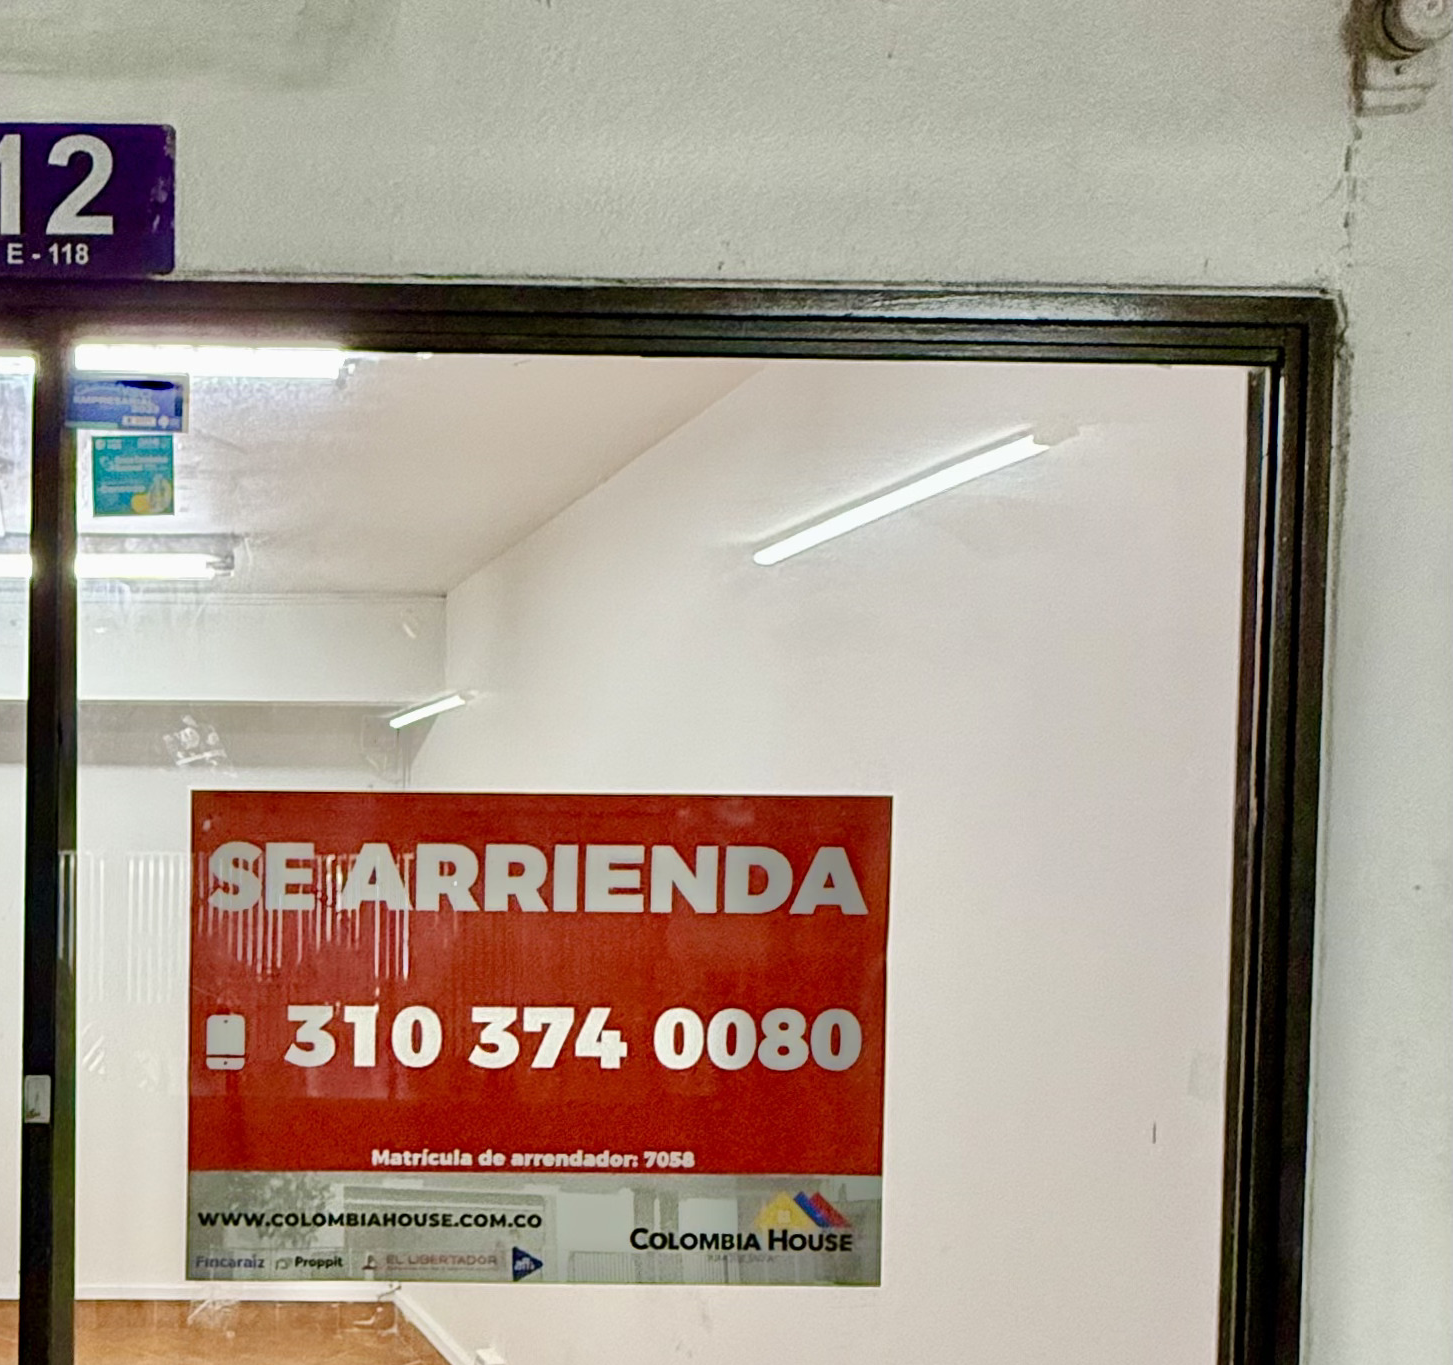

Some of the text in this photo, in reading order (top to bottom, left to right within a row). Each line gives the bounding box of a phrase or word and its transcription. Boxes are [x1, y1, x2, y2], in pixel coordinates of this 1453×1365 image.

[6, 242, 24, 265] E
[48, 242, 89, 265] 118
[208, 841, 870, 915] SE ARRIENDA
[284, 1004, 863, 1072] 310 374 0080
[371, 1148, 696, 1168] Matrícula de arrendador: 7058
[198, 1212, 543, 1229] WWW.COLOMBIAHOUSE.COM.CO
[294, 1255, 344, 1270] Proppit
